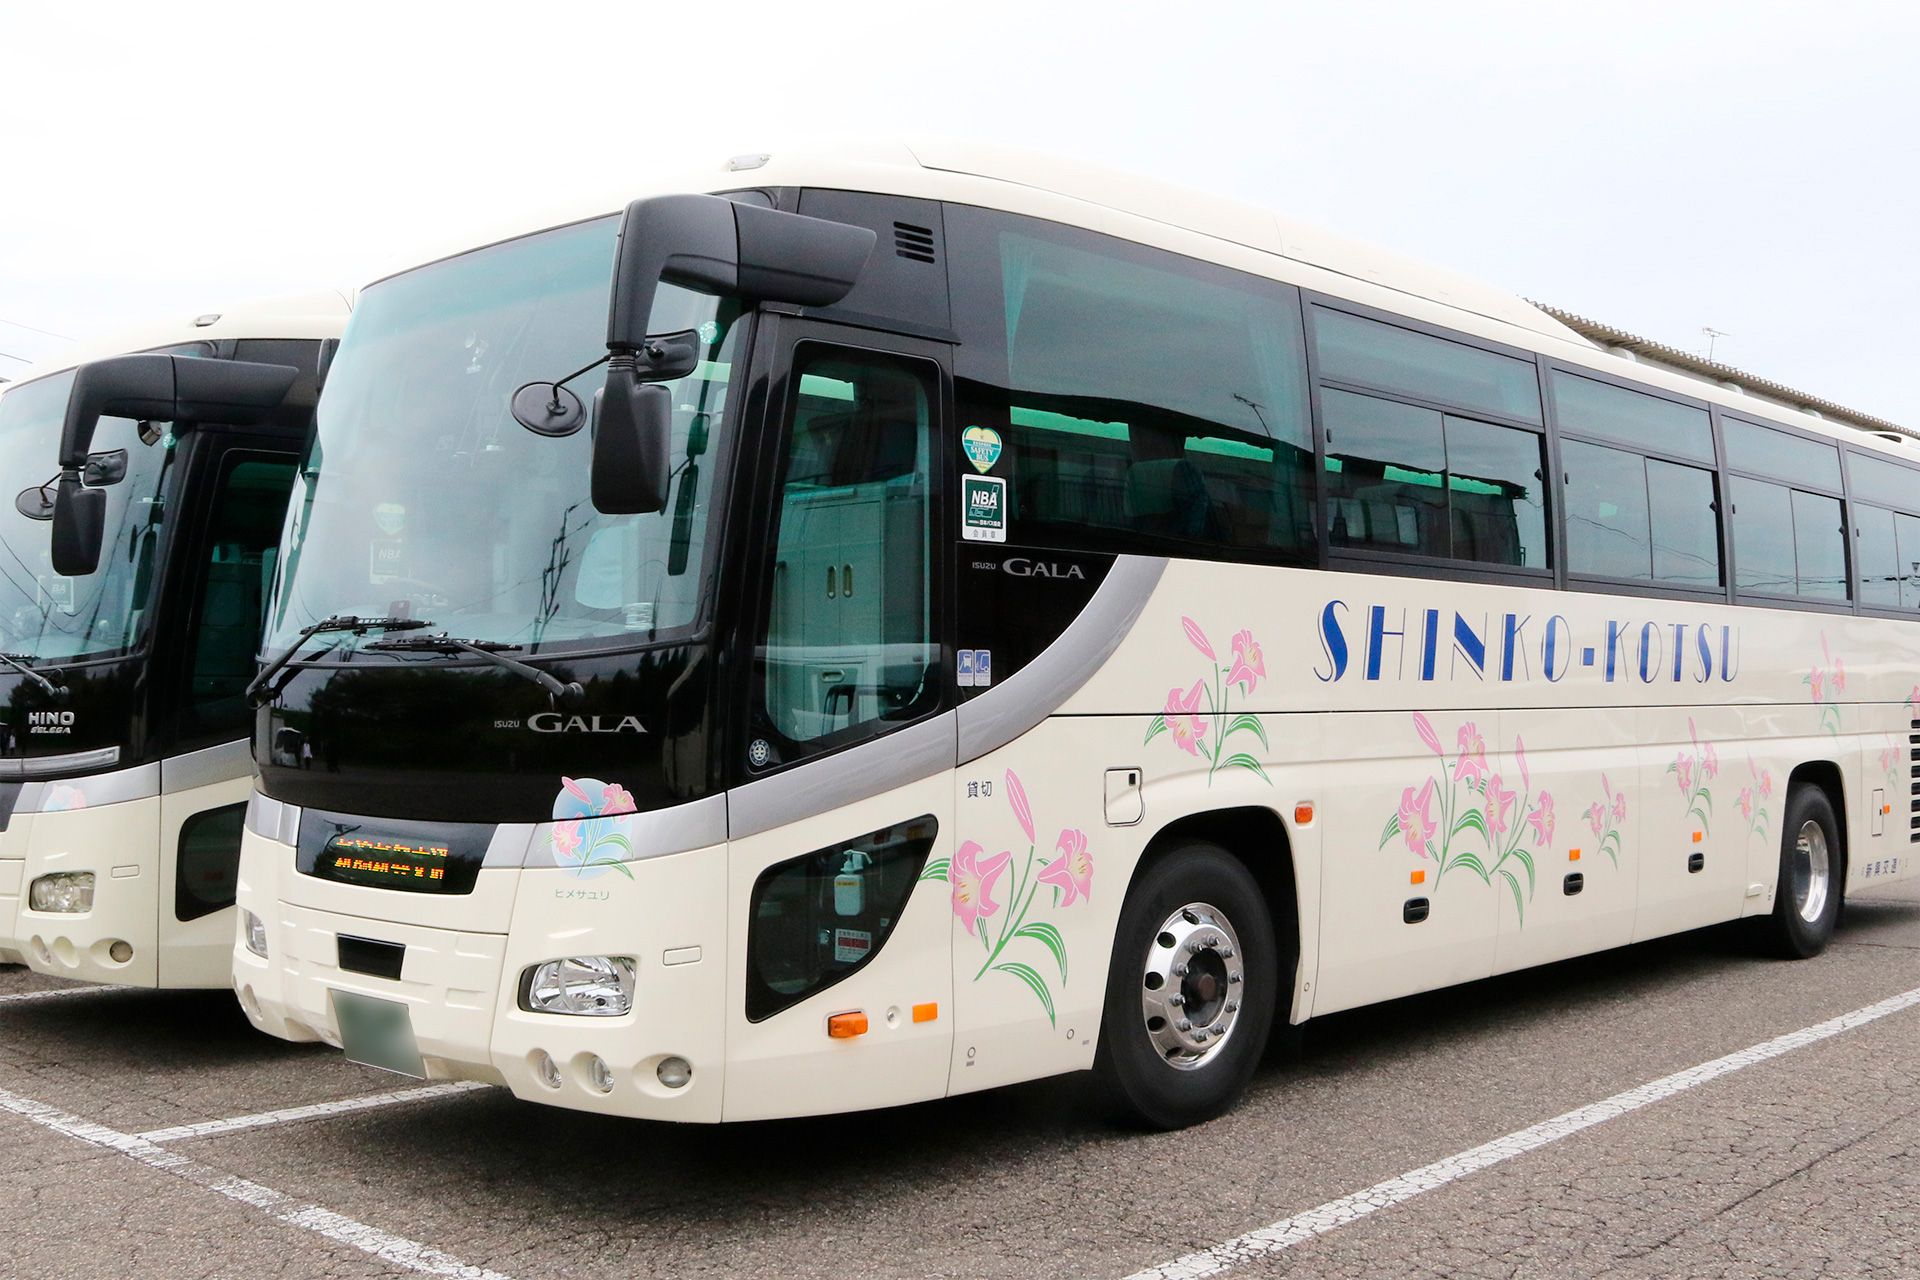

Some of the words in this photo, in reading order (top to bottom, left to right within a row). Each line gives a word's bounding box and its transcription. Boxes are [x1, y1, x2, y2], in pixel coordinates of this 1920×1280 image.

[971, 490, 998, 506] NBA
[972, 561, 997, 570] ISUZU
[1002, 557, 1086, 580] GALA
[28, 711, 75, 726] HINO
[494, 720, 520, 729] ISUZU
[527, 712, 649, 733] GALA
[967, 780, 993, 799] 貸切
[555, 889, 610, 901] ヒメサユリ
